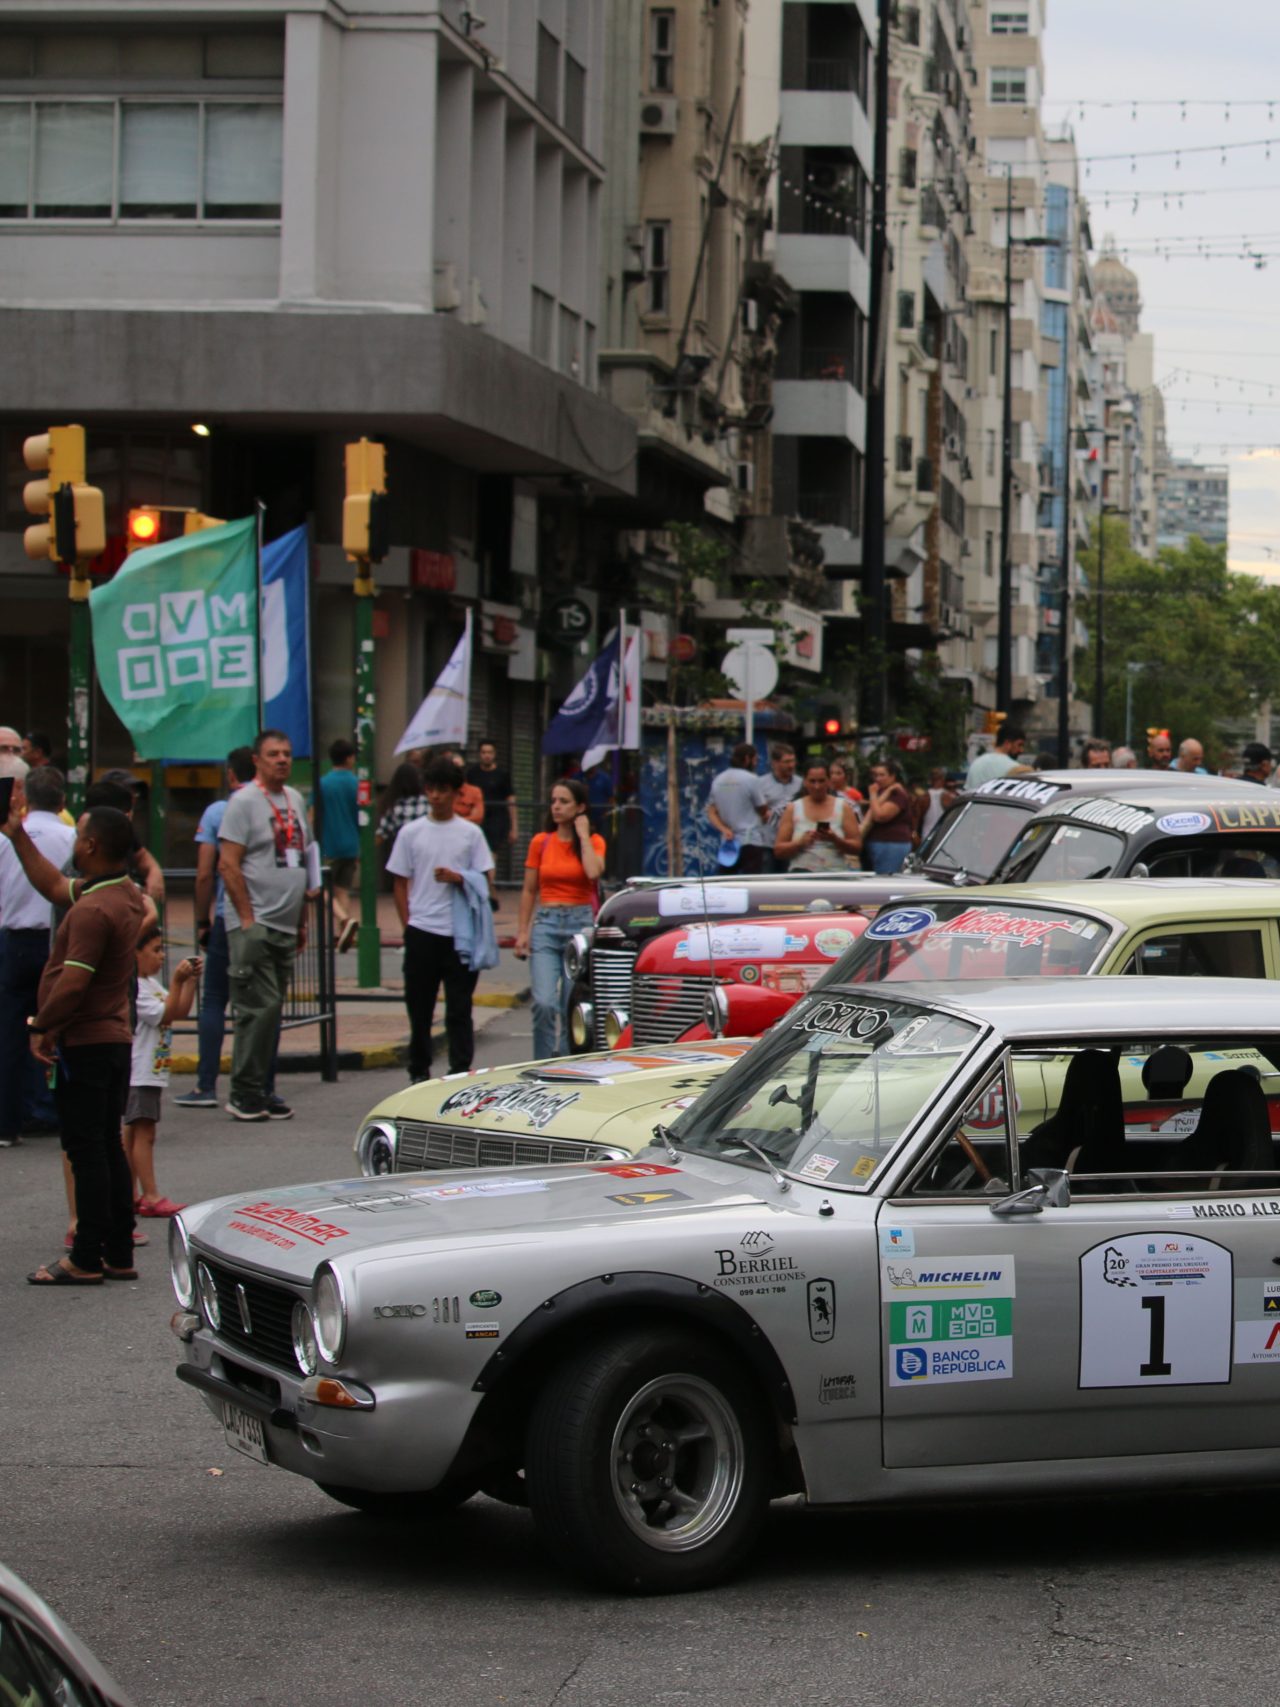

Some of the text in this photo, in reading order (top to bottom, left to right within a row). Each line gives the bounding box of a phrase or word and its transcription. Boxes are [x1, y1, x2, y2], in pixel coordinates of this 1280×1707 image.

[875, 911, 923, 933] Ford
[792, 1001, 890, 1040] TORINO
[1192, 1203, 1246, 1218] MARIO
[714, 1249, 798, 1276] BERRIEL
[713, 1272, 806, 1287] CONSTRUCCIONES
[918, 1271, 1002, 1283] MICHELIN
[951, 1305, 995, 1320] MVD
[1139, 1295, 1172, 1376] 1
[932, 1350, 980, 1363] BANCO
[932, 1360, 1006, 1375] REPÚBLICA
